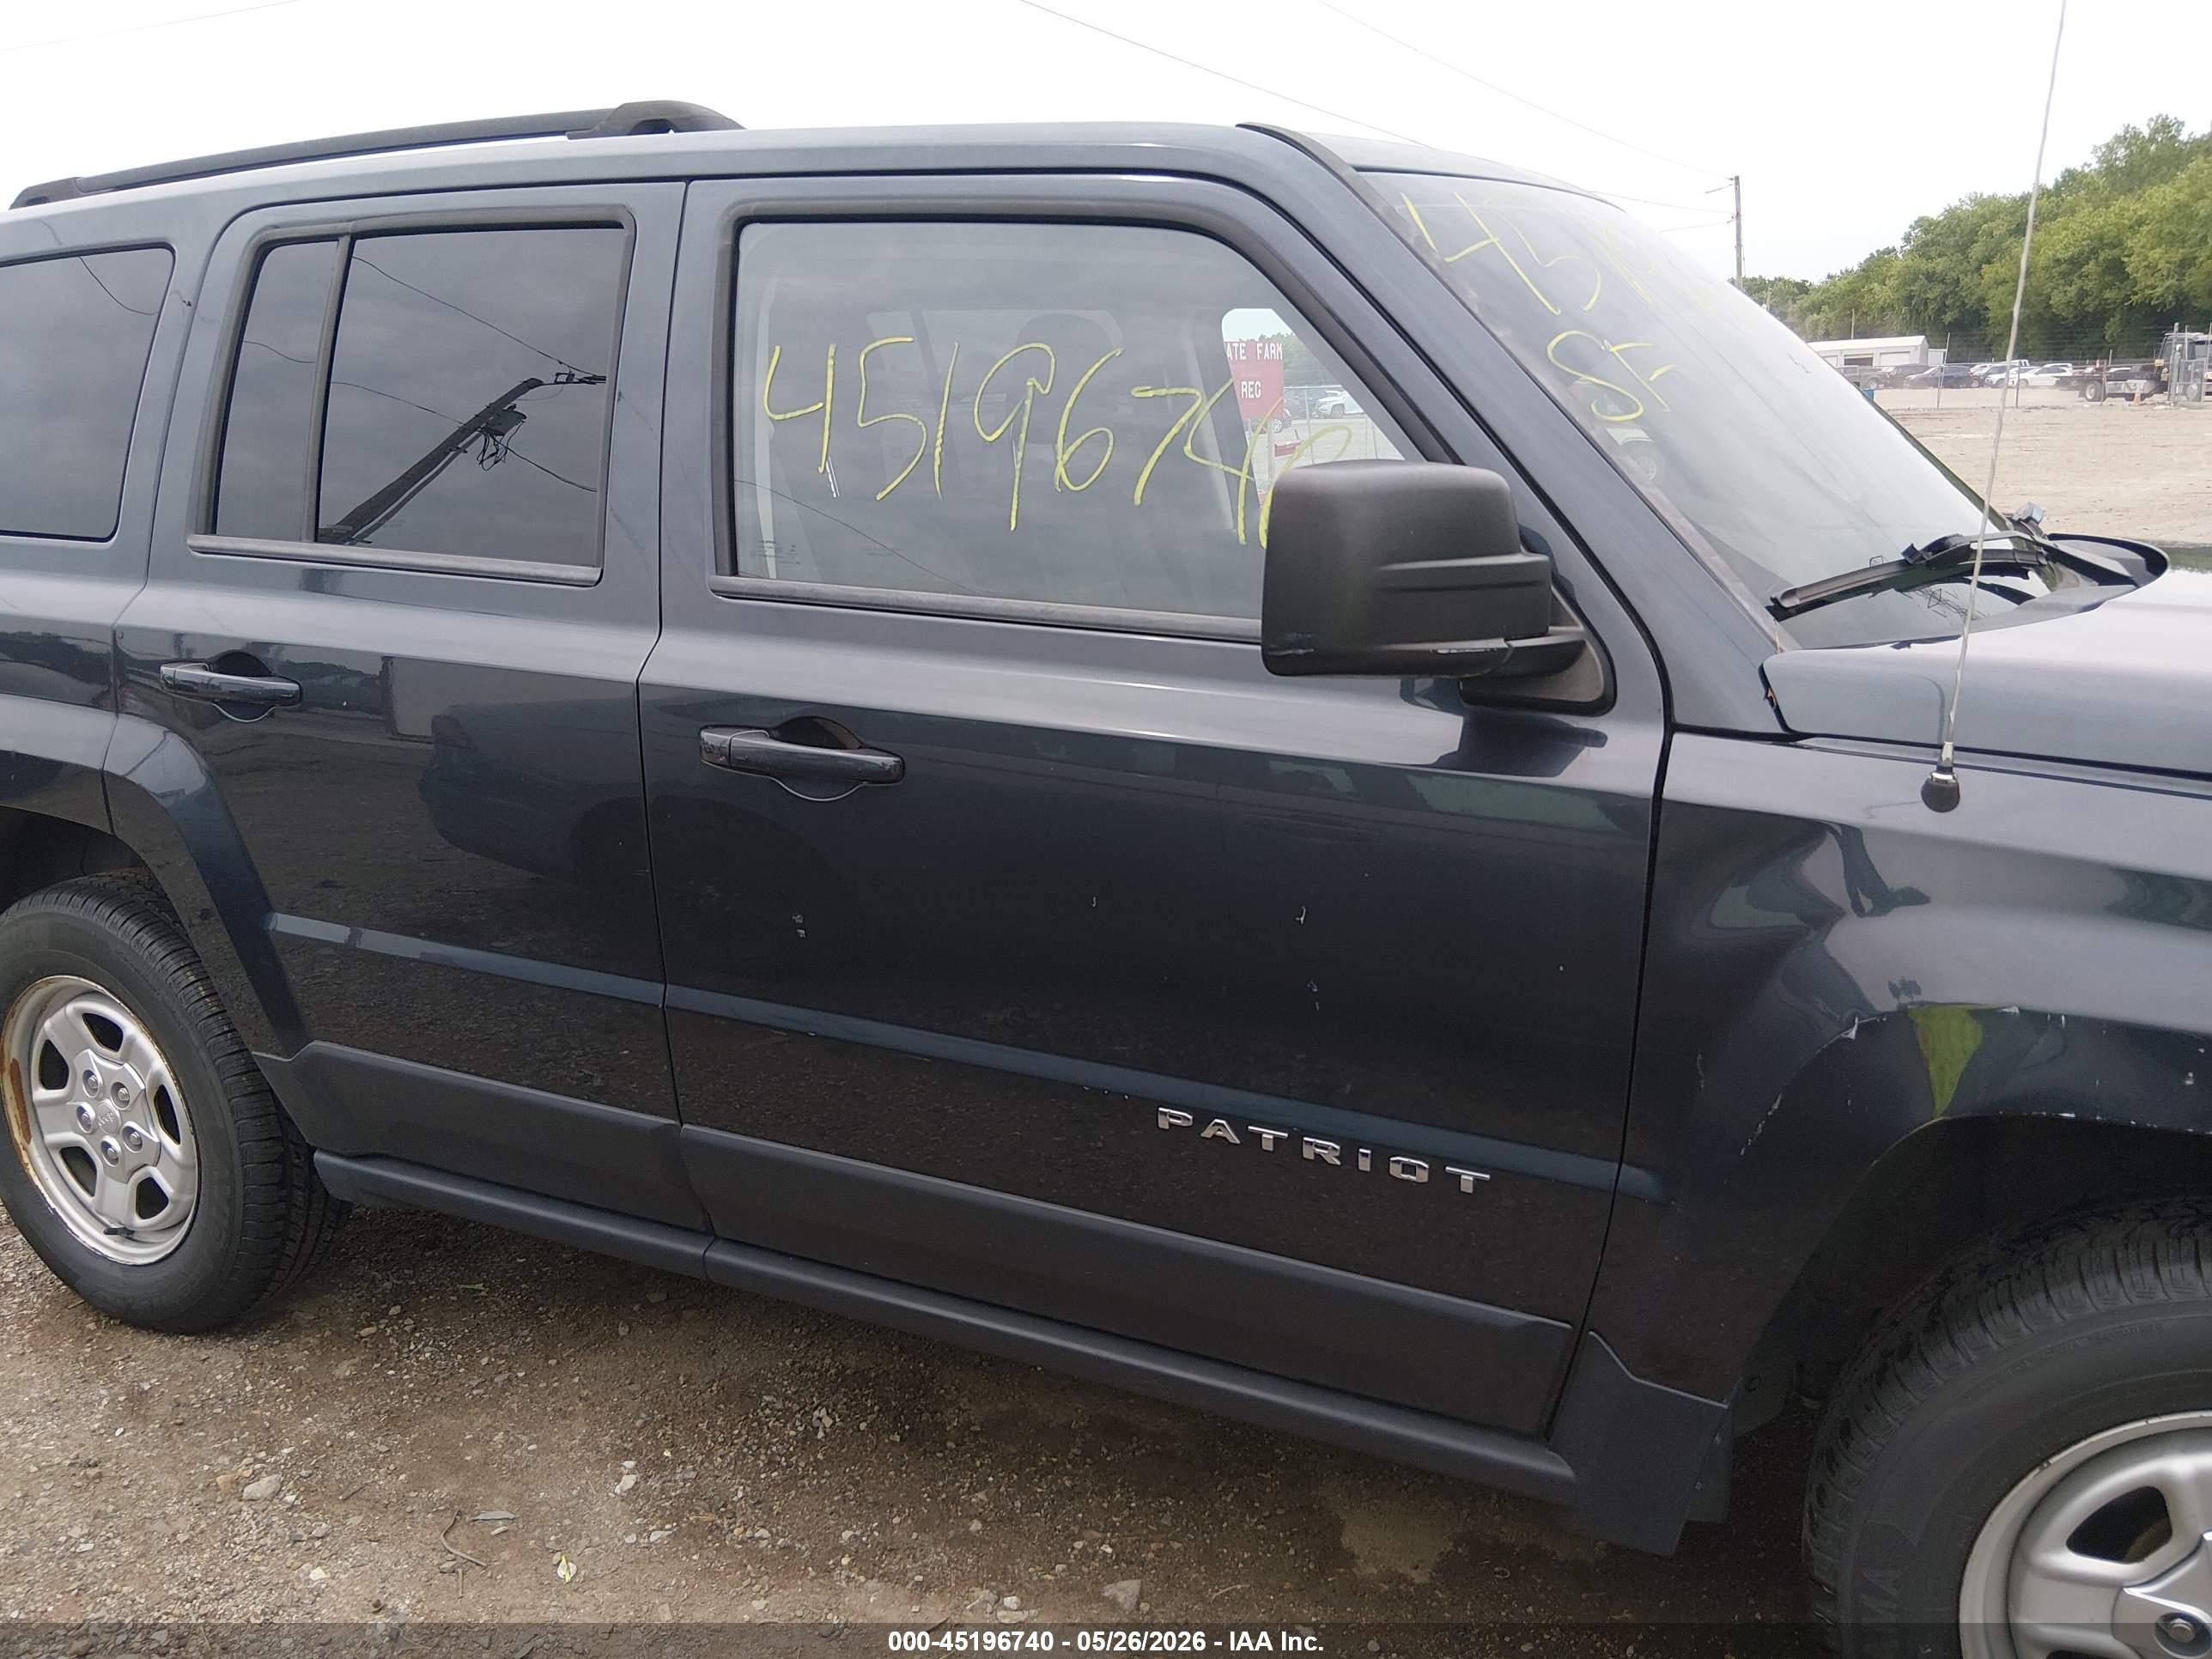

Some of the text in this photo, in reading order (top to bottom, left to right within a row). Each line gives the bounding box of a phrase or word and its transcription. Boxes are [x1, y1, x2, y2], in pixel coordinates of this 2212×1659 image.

[1226, 343, 1283, 361] ATE FARM
[1158, 1106, 1492, 1194] PATRIOT
